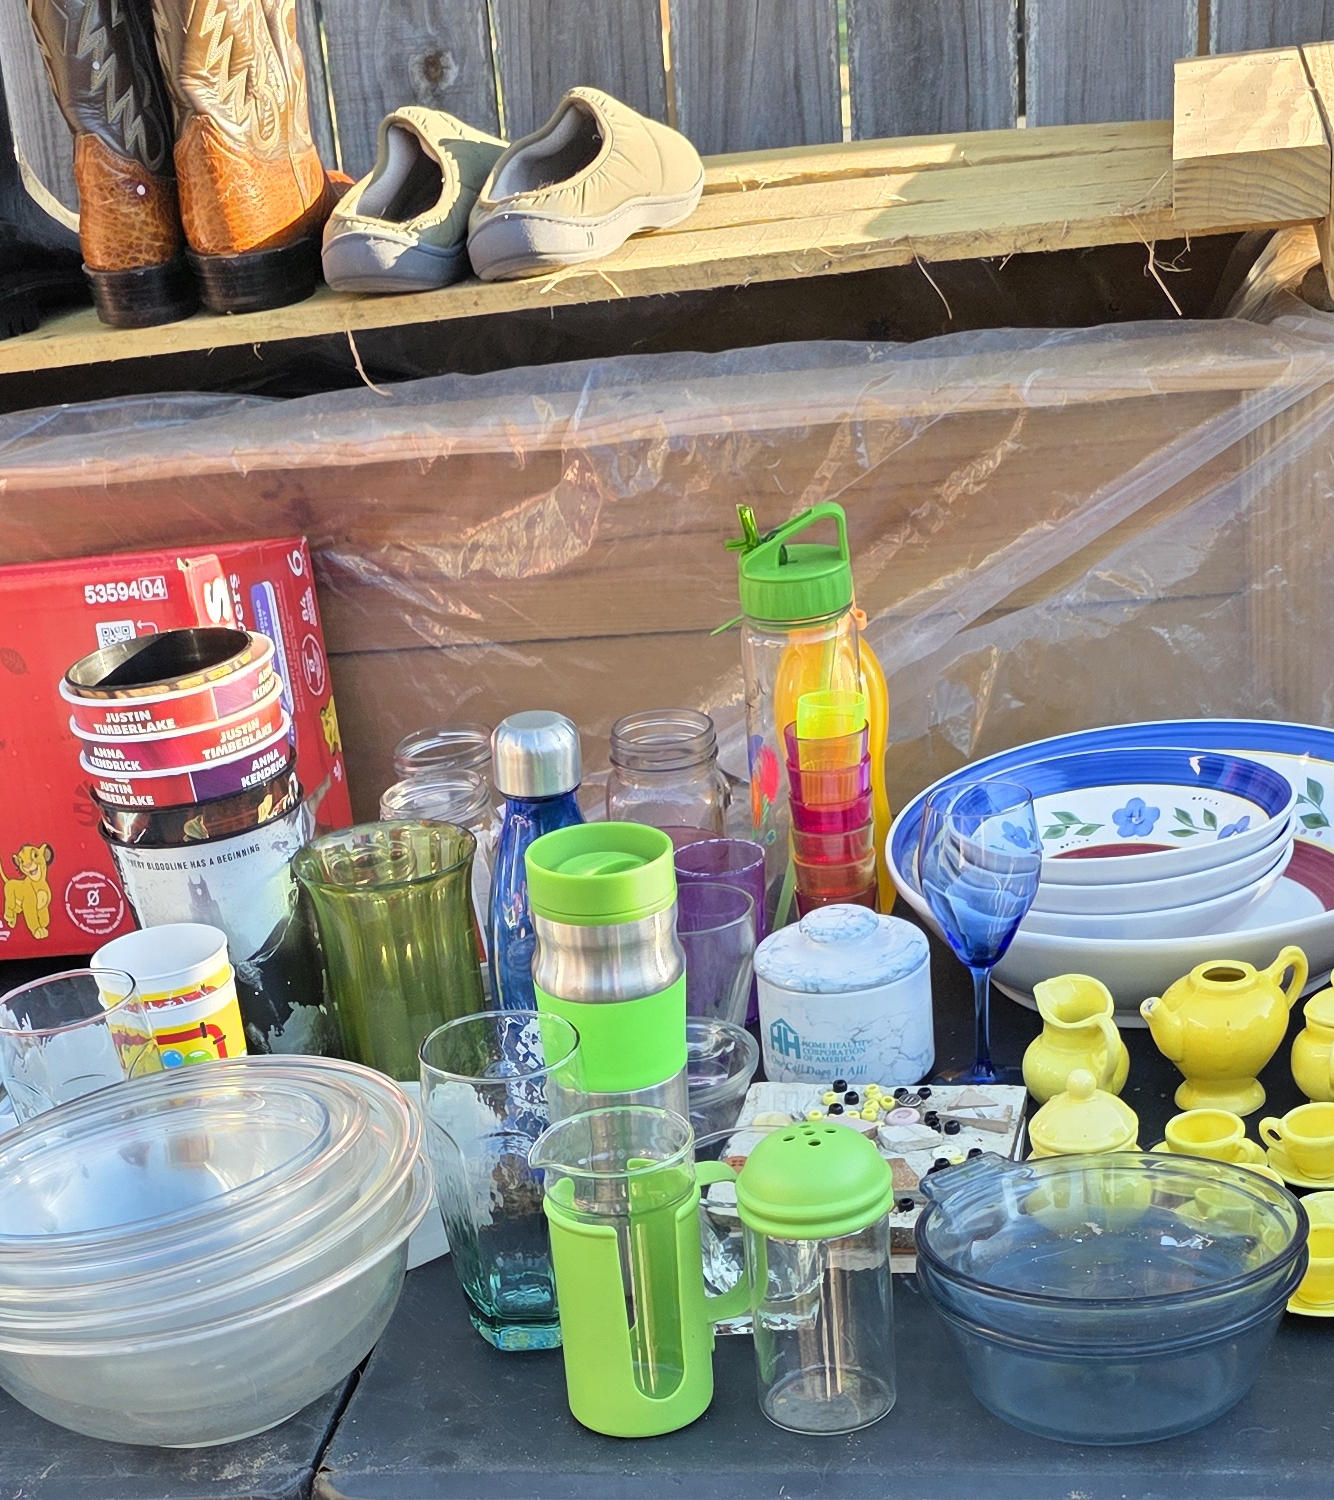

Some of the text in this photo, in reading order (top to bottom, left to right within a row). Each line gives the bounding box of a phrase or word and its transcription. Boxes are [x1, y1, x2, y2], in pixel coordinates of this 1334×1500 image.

[286, 550, 303, 577] 6
[84, 577, 167, 604] 5359404
[105, 710, 151, 723] JUSTIN
[93, 718, 175, 734] TIMBERLAKE
[220, 717, 260, 743] JUSTIN
[93, 747, 125, 760] ANNA
[251, 748, 280, 771] ANNA
[90, 756, 141, 771] KENDRICK
[241, 755, 287, 788] KENDRICK
[128, 843, 260, 871] VERY BLOODLINE HAS A BEGINNING
[801, 1039, 865, 1049] HOME HEALTH
[803, 1047, 866, 1056] CORPORATION
[815, 1055, 856, 1063] AMERICA
[807, 1066, 831, 1076] Does
[835, 1067, 844, 1076] It
